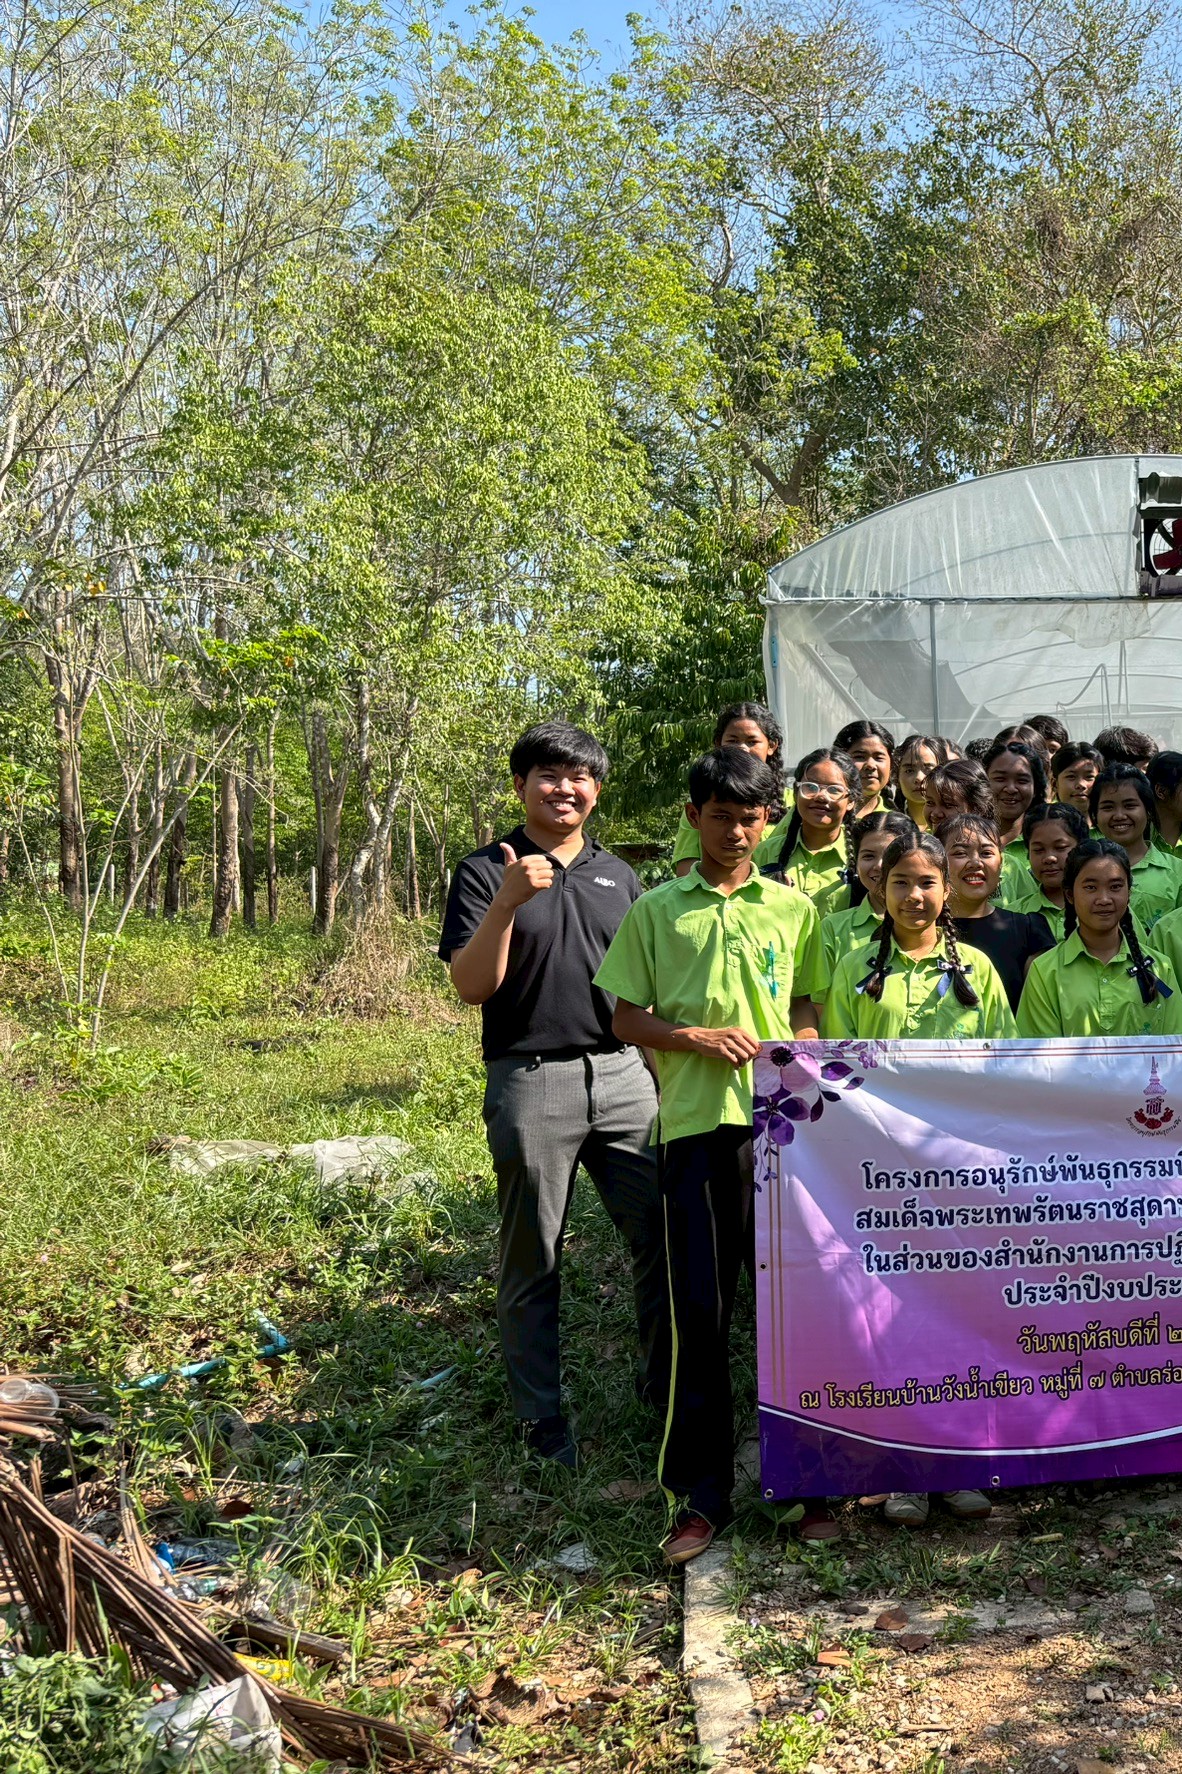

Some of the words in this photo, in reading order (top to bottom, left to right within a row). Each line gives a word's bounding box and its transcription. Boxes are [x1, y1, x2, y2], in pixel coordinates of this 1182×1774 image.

[1018, 1314, 1160, 1354] วันพฤหัสบดีที่
[800, 1390, 820, 1409] ณ
[826, 1367, 1034, 1408] โรงเรียนบ้านวังน้ำเขียว
[1041, 1363, 1083, 1399] หมู่ที่
[1089, 1374, 1106, 1389] ๗
